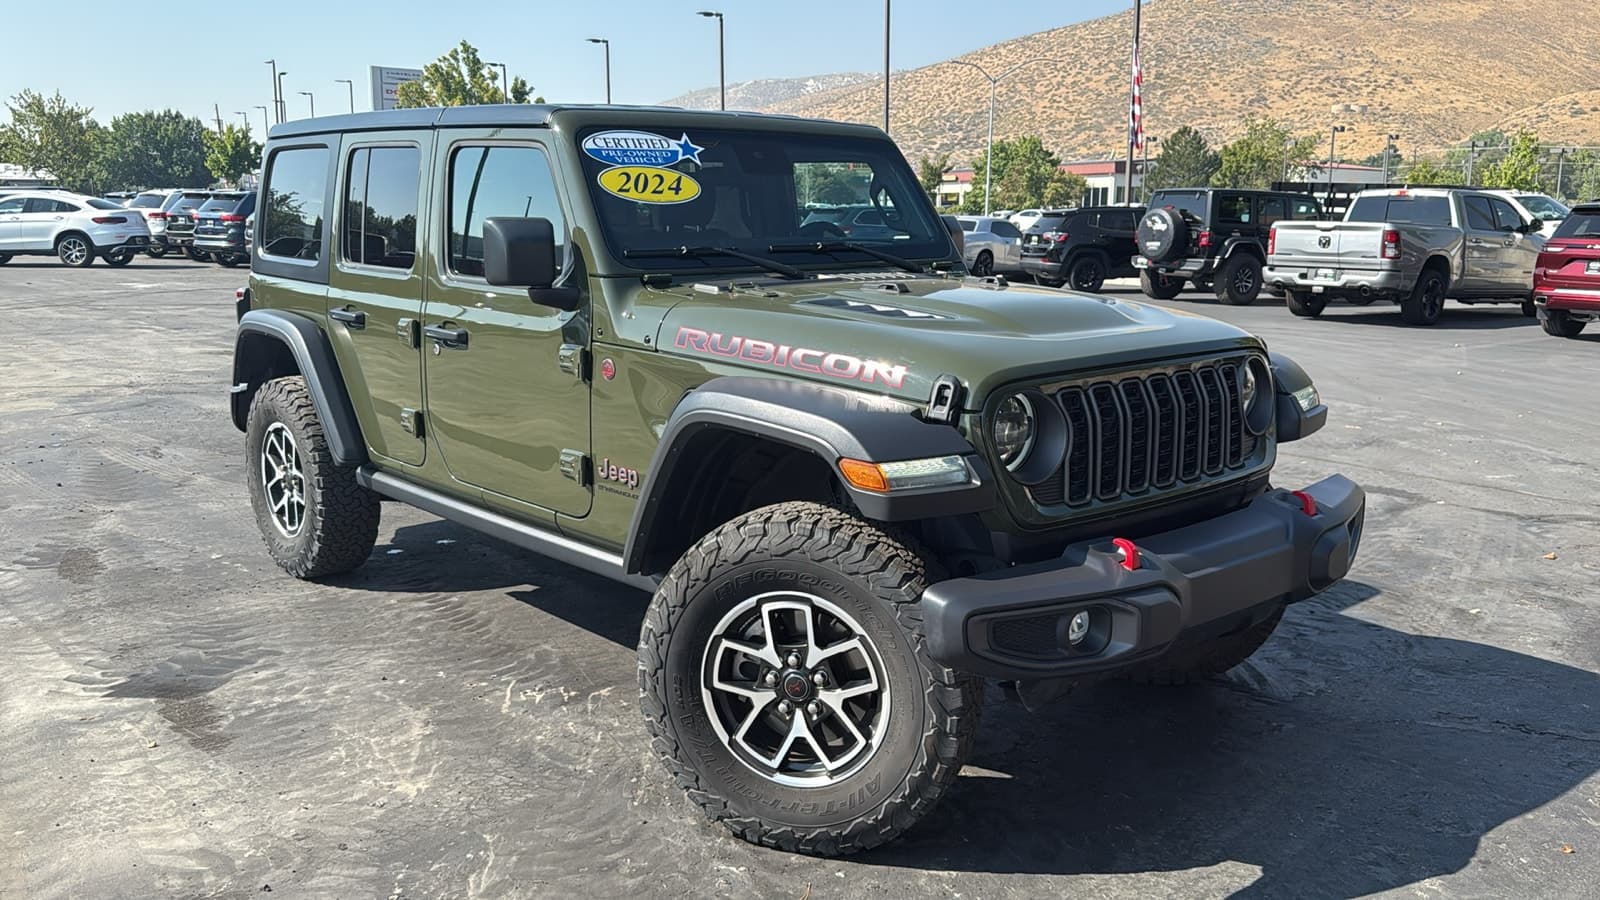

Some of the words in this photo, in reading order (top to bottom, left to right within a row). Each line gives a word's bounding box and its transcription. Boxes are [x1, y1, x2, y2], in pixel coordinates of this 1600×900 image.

[592, 137, 671, 149] CERTIFIED
[602, 150, 671, 158] PRE-OWNED
[615, 156, 665, 165] VEHICLE
[617, 172, 682, 195] 2024
[674, 326, 908, 388] RUBICON
[598, 458, 639, 490] Jeep
